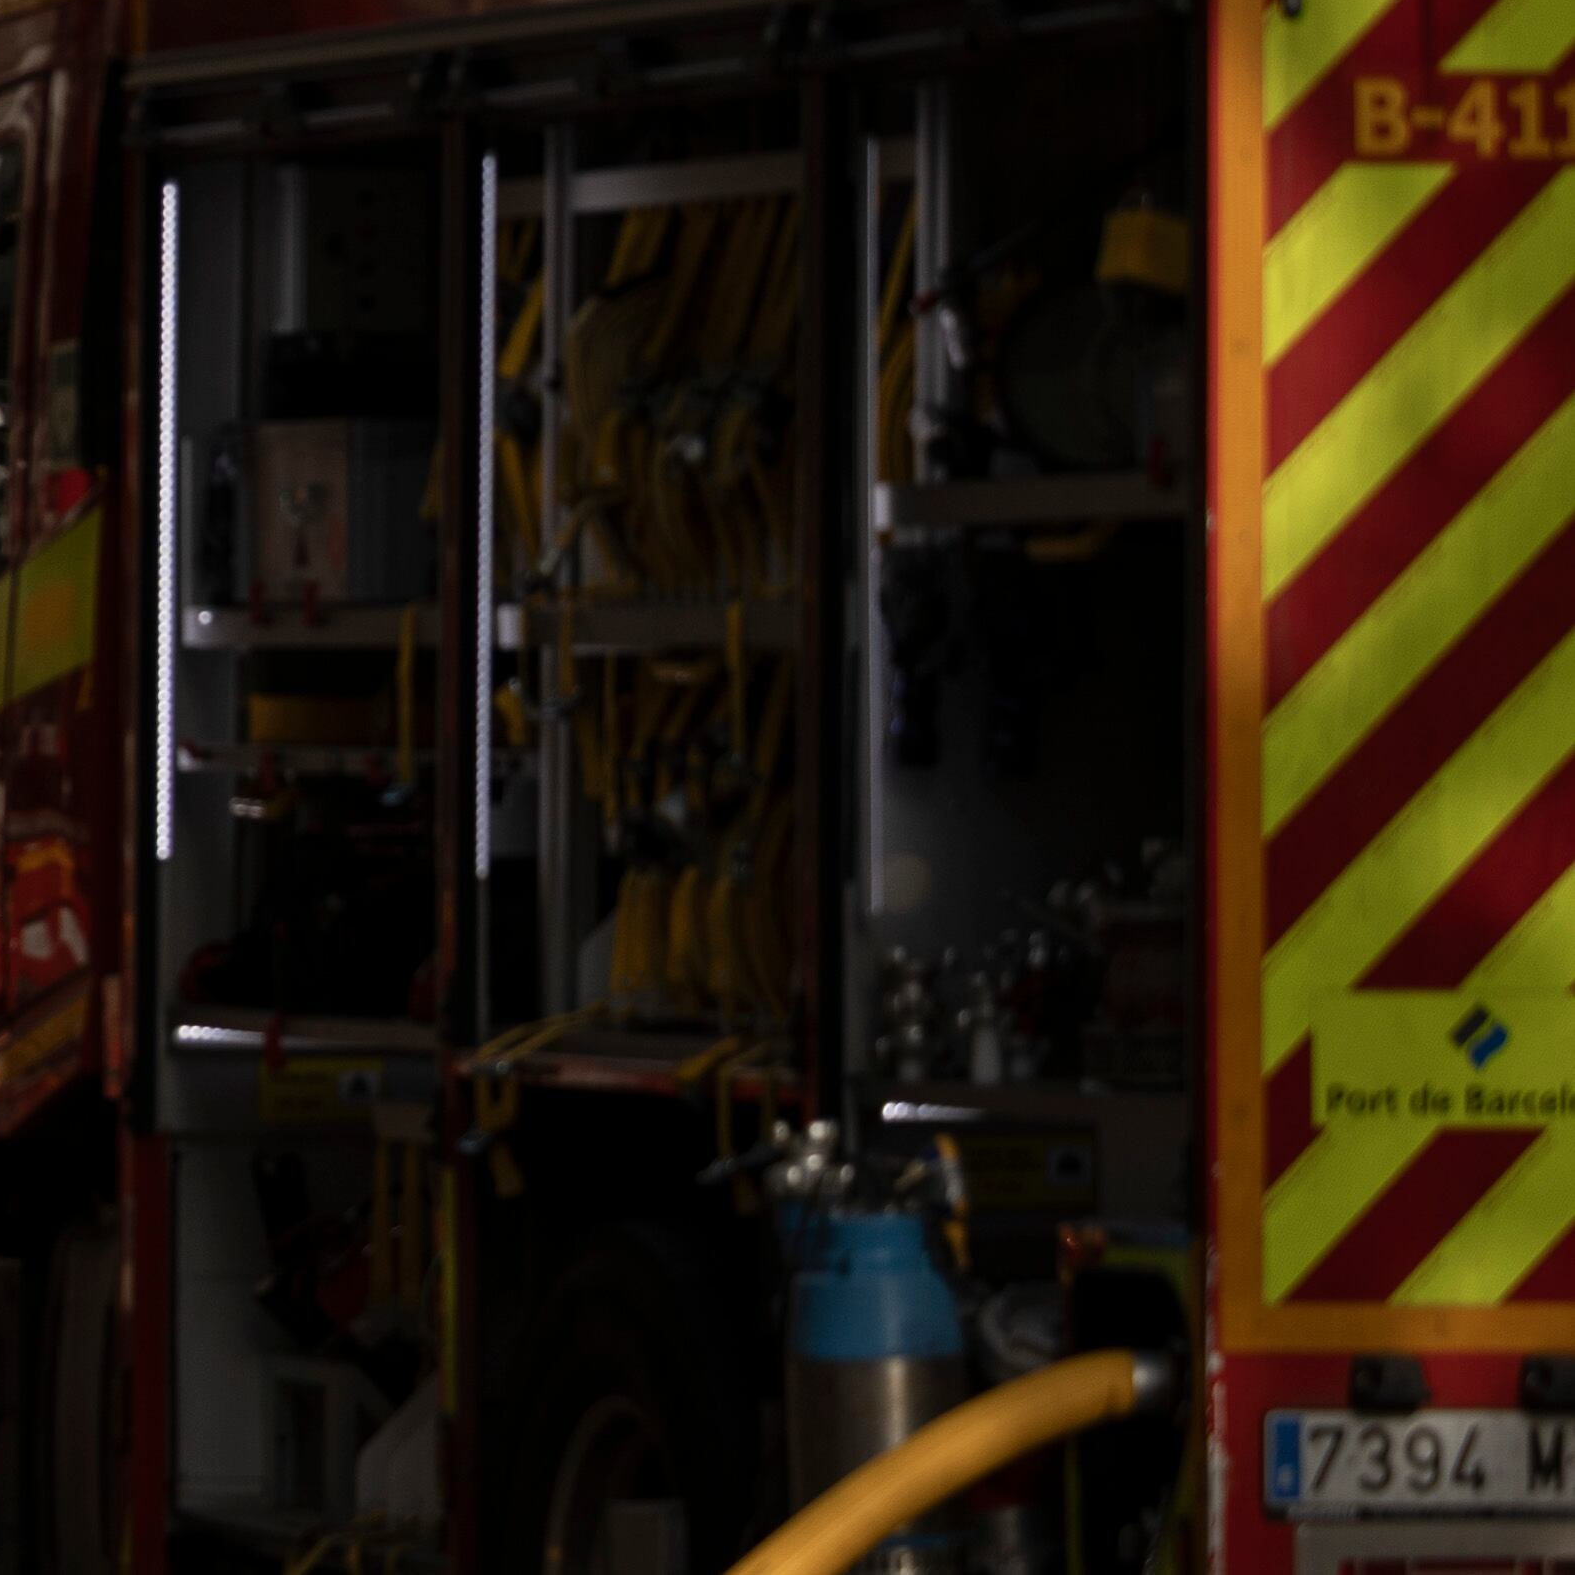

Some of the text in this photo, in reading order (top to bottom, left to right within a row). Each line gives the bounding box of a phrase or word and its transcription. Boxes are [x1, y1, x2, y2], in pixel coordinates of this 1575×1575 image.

[1326, 1082, 1398, 1116] Port
[1409, 1079, 1452, 1115] de
[1307, 1423, 1485, 1493] 7394
